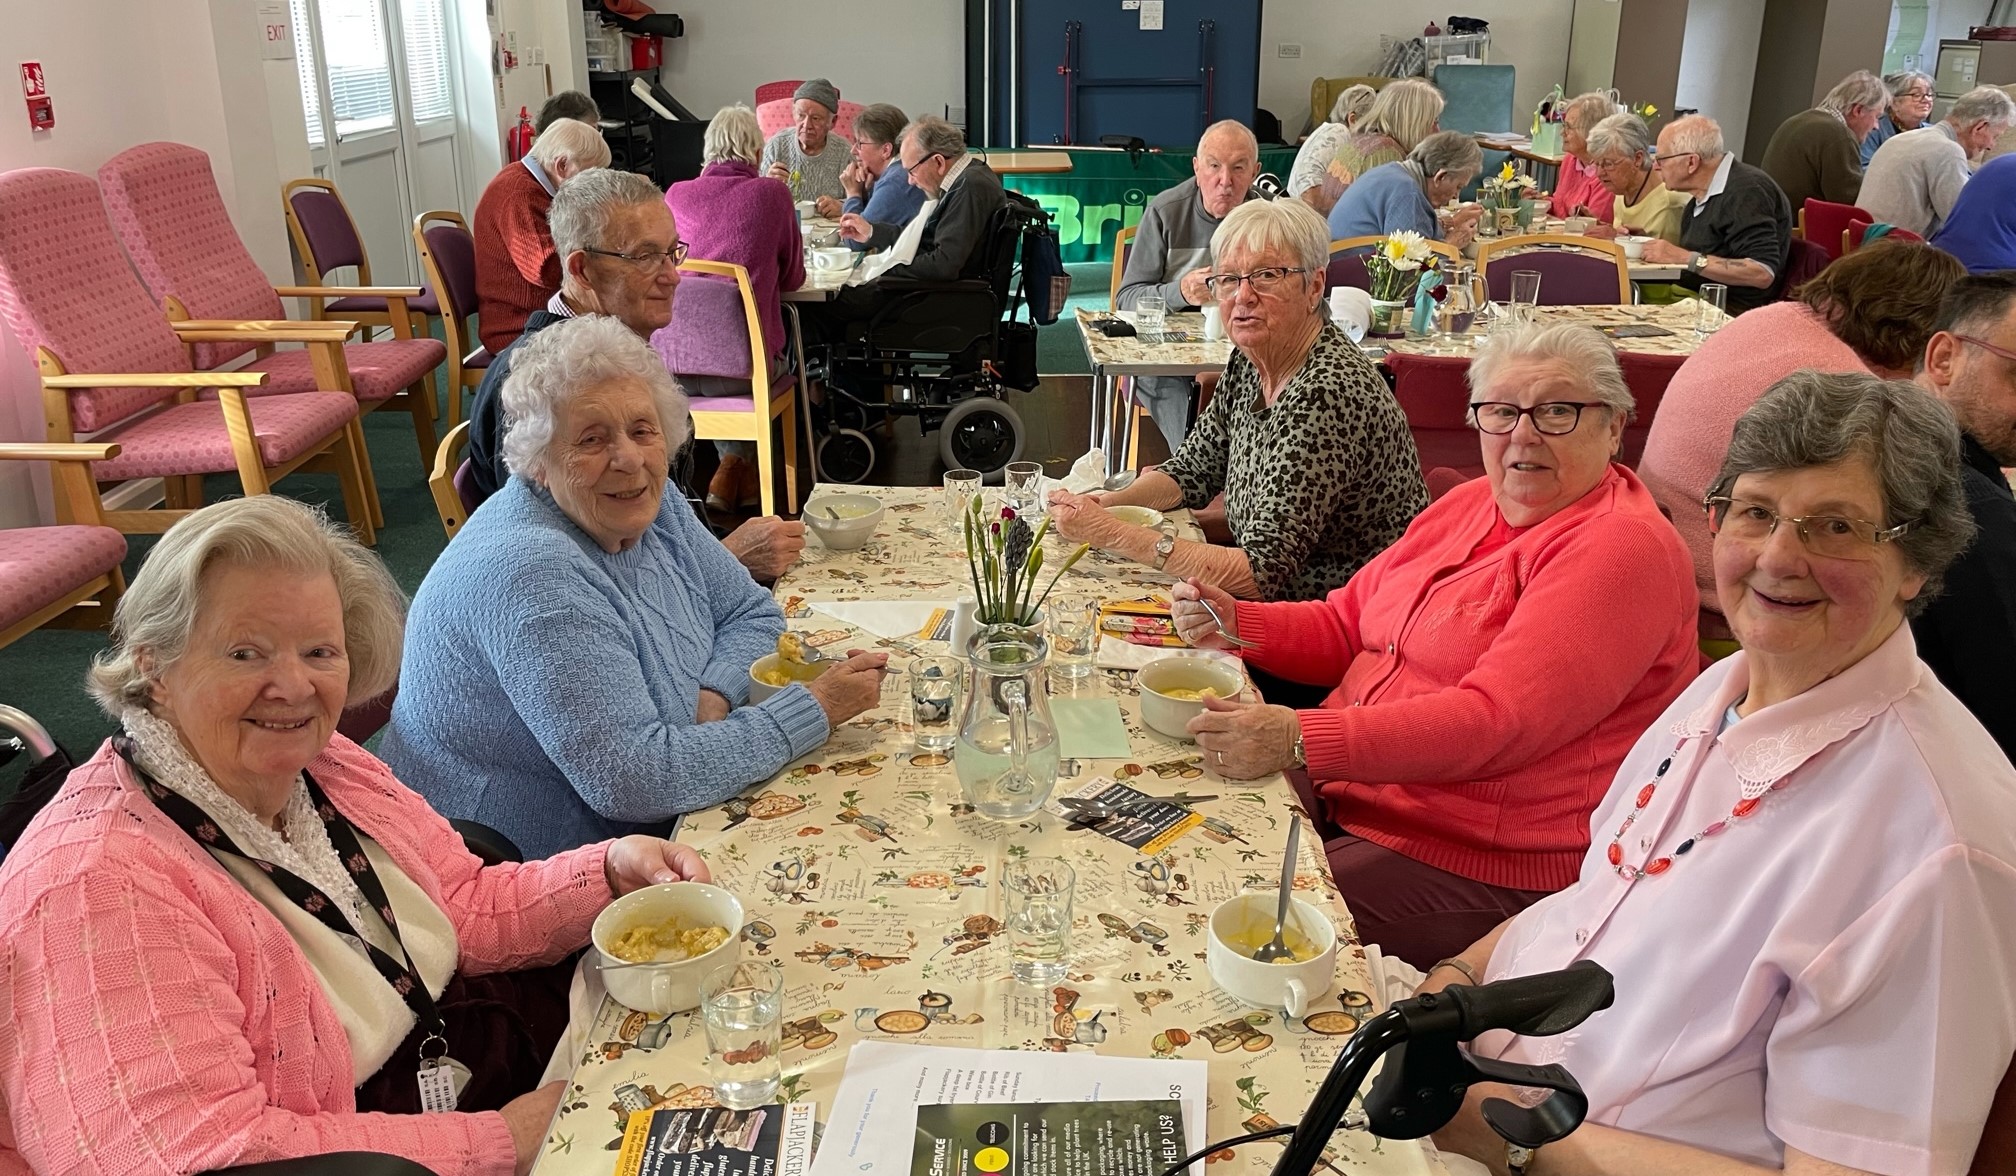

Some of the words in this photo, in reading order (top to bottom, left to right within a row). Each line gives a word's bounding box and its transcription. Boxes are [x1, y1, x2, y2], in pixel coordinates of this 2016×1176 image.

[267, 25, 285, 41] EXIT
[1169, 1084, 1181, 1099] SC
[1159, 1114, 1174, 1134] US?
[785, 1112, 809, 1176] FLAPJACKER
[1074, 1134, 1082, 1147] plant
[1133, 1124, 1143, 1153] generating
[929, 1138, 947, 1176] SERVICE
[1031, 1143, 1039, 1162] looking
[1107, 1150, 1115, 1168] recycle
[1162, 1138, 1178, 1164] HELP
[655, 1153, 665, 1170] Order
